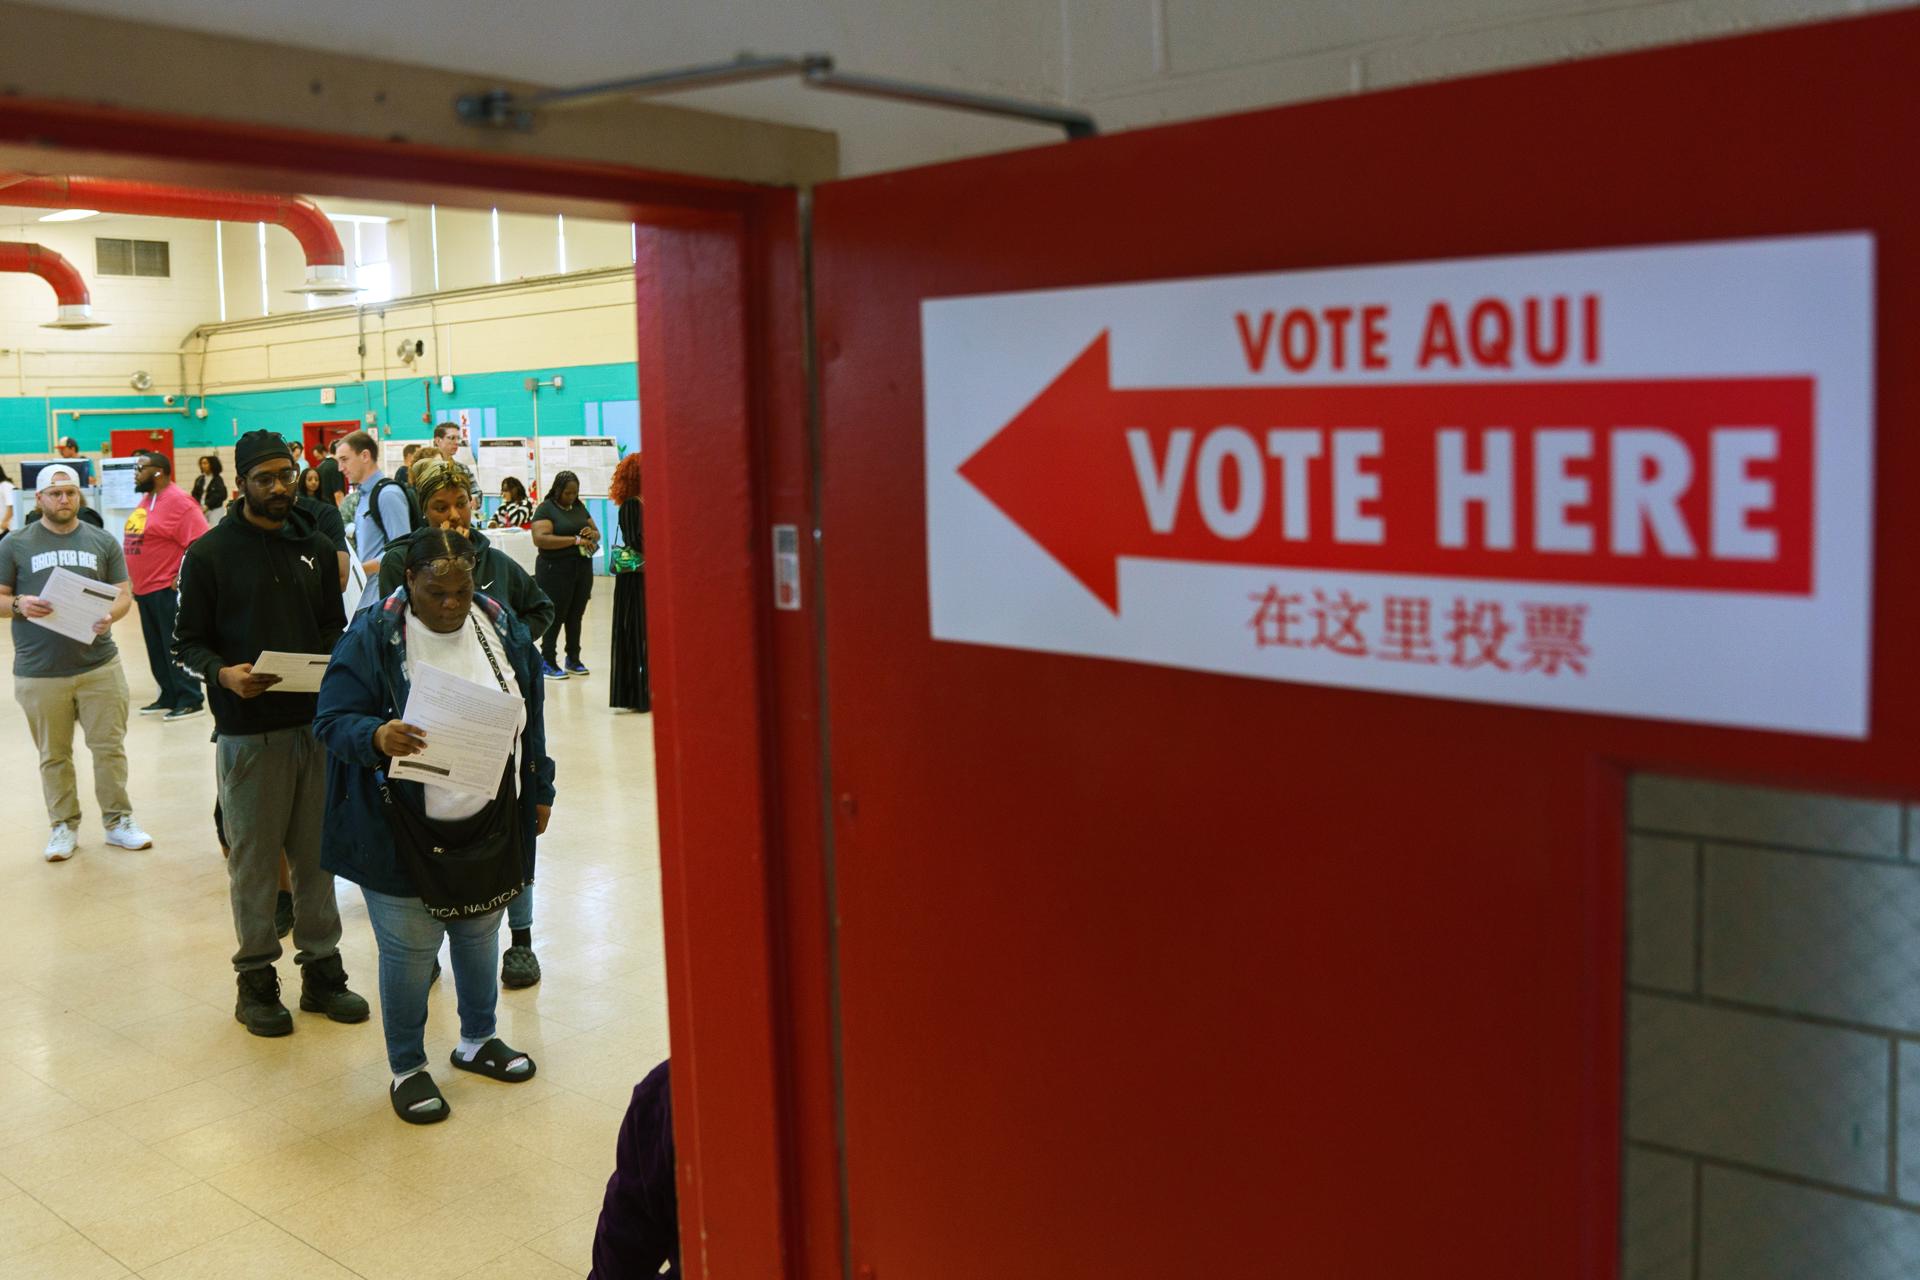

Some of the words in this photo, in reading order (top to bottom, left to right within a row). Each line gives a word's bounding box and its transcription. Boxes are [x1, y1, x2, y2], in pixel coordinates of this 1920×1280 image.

[1235, 305, 1389, 373] VOTE
[1416, 294, 1600, 370] AQUI
[1125, 426, 1386, 545] VOTE
[1435, 427, 1780, 561] HERE
[31, 551, 58, 573] BROS
[57, 550, 78, 566] FOR
[475, 623, 501, 676] NAUTICA
[1249, 586, 1592, 676] 在这里投票
[425, 903, 460, 918] TICA
[464, 888, 519, 914] NAUTICA
